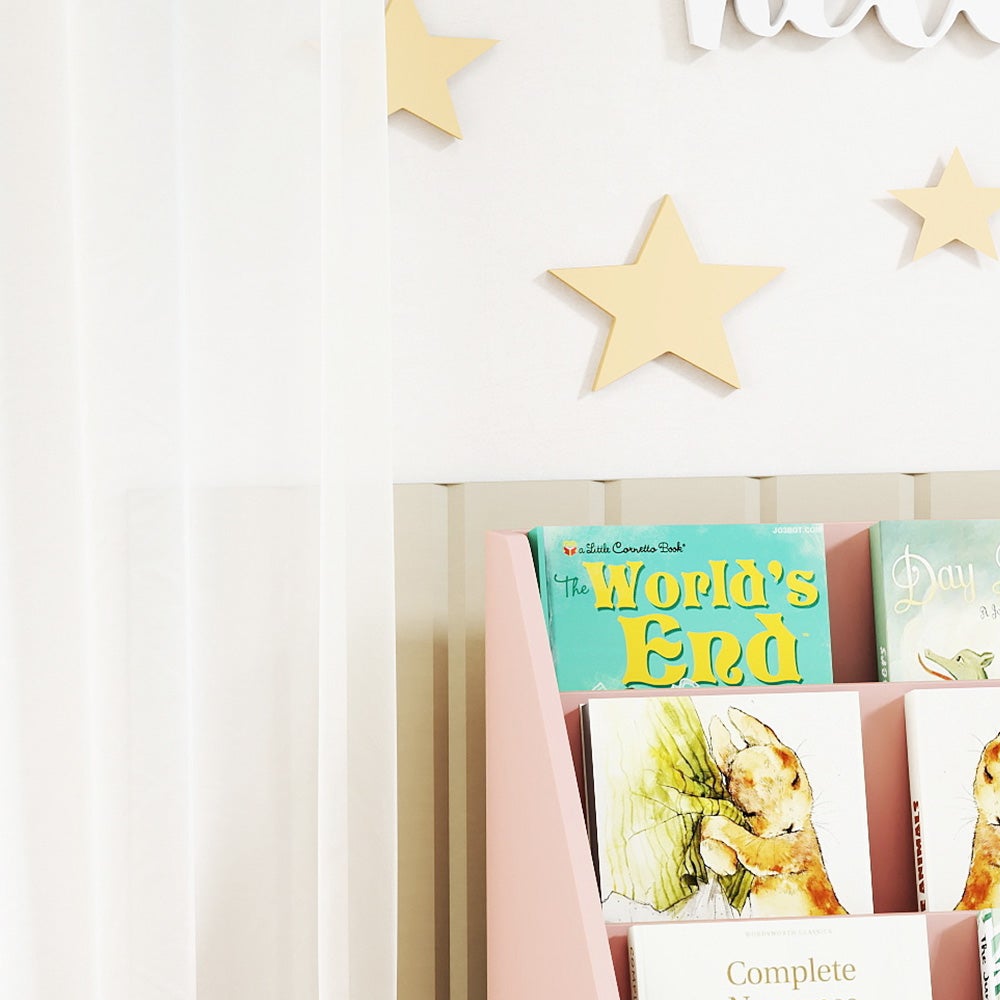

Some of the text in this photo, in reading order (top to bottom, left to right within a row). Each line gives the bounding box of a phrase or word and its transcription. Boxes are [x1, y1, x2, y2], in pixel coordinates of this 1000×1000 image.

[578, 546, 585, 554] a
[586, 542, 611, 554] Little
[612, 541, 657, 554] Cornetto
[553, 559, 820, 610] The World's
[892, 543, 975, 614] Day
[980, 605, 989, 619] A
[617, 612, 803, 688] End
[727, 957, 856, 990] Complete
